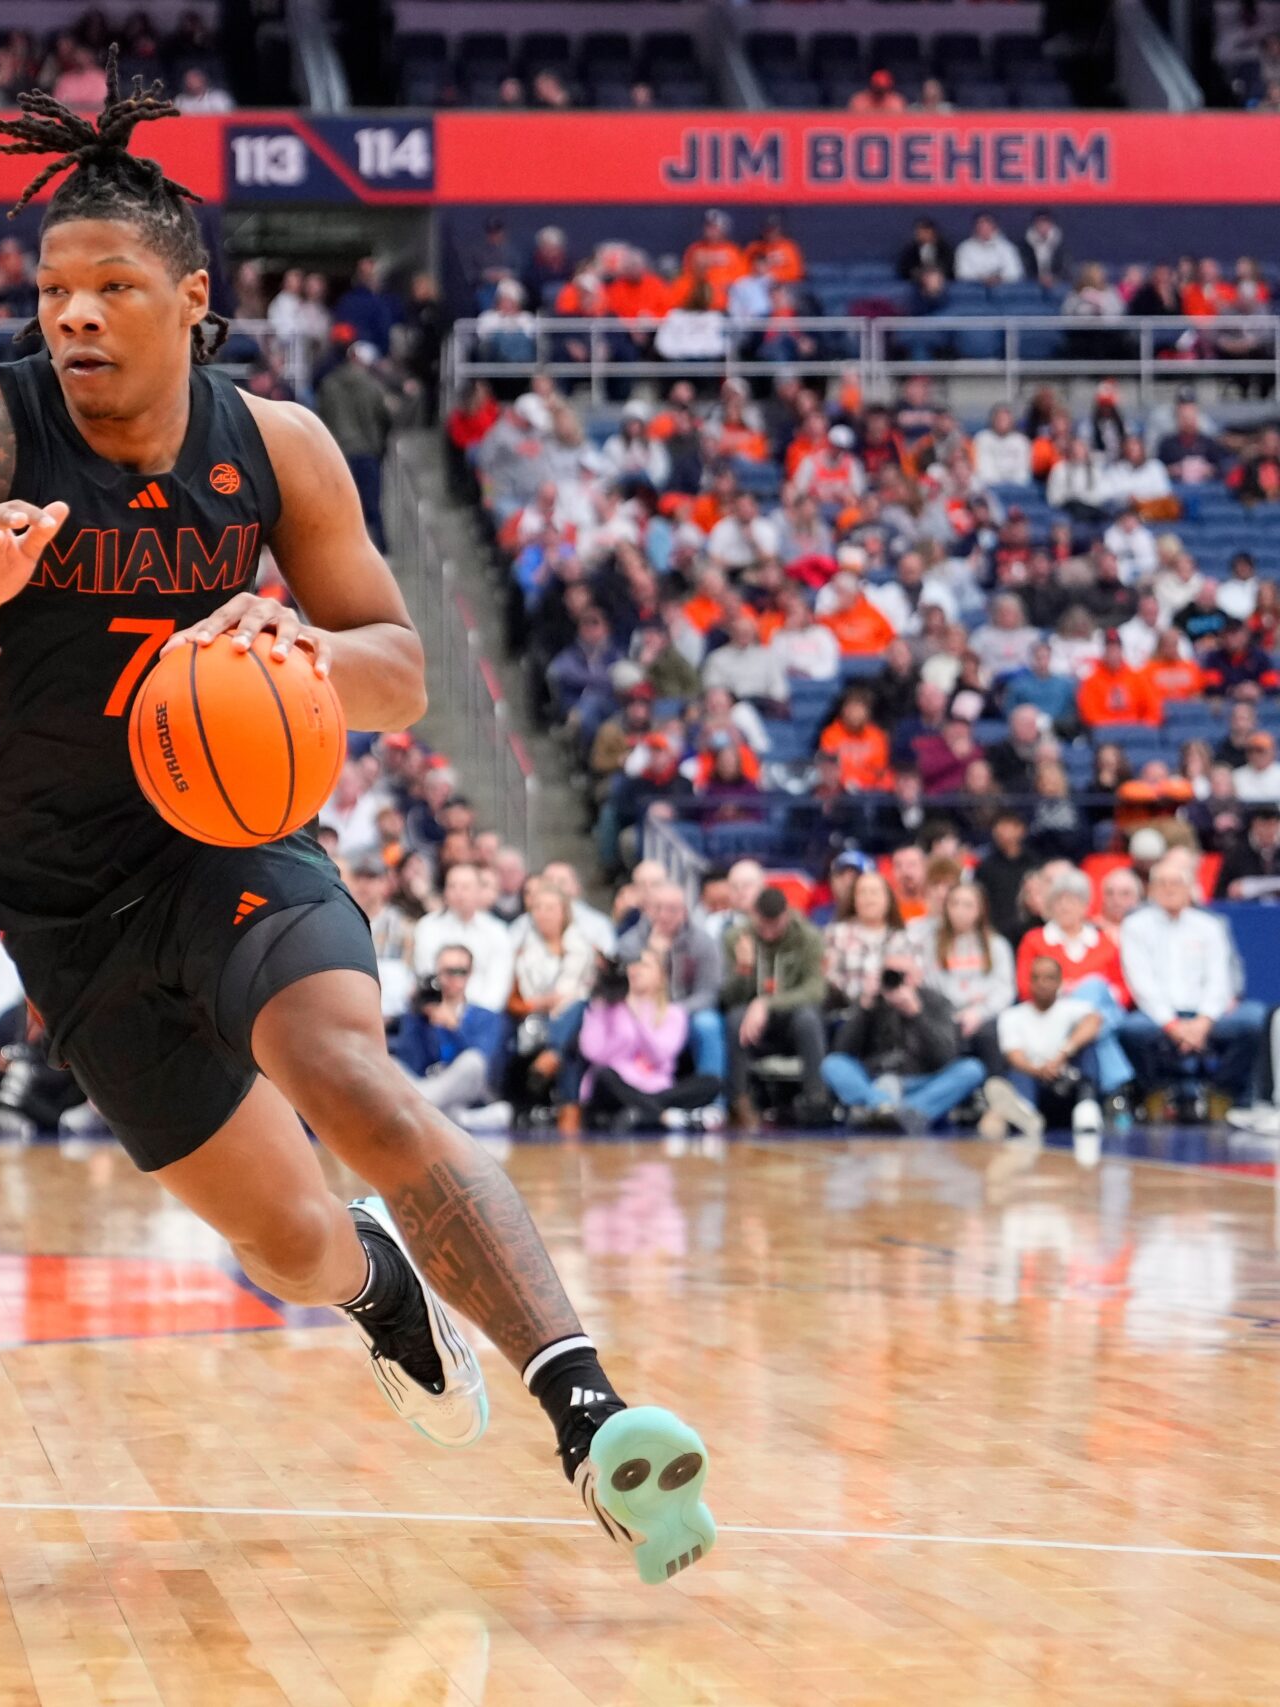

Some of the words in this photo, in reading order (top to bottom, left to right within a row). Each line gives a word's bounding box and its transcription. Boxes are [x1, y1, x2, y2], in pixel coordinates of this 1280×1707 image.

[231, 135, 307, 186] 113
[354, 127, 430, 179] 114
[664, 133, 782, 183] JIM
[808, 133, 1110, 184] BOEHEIM
[27, 522, 260, 594] MIAMI
[103, 617, 176, 717] 7
[155, 701, 189, 793] SYRACUSE
